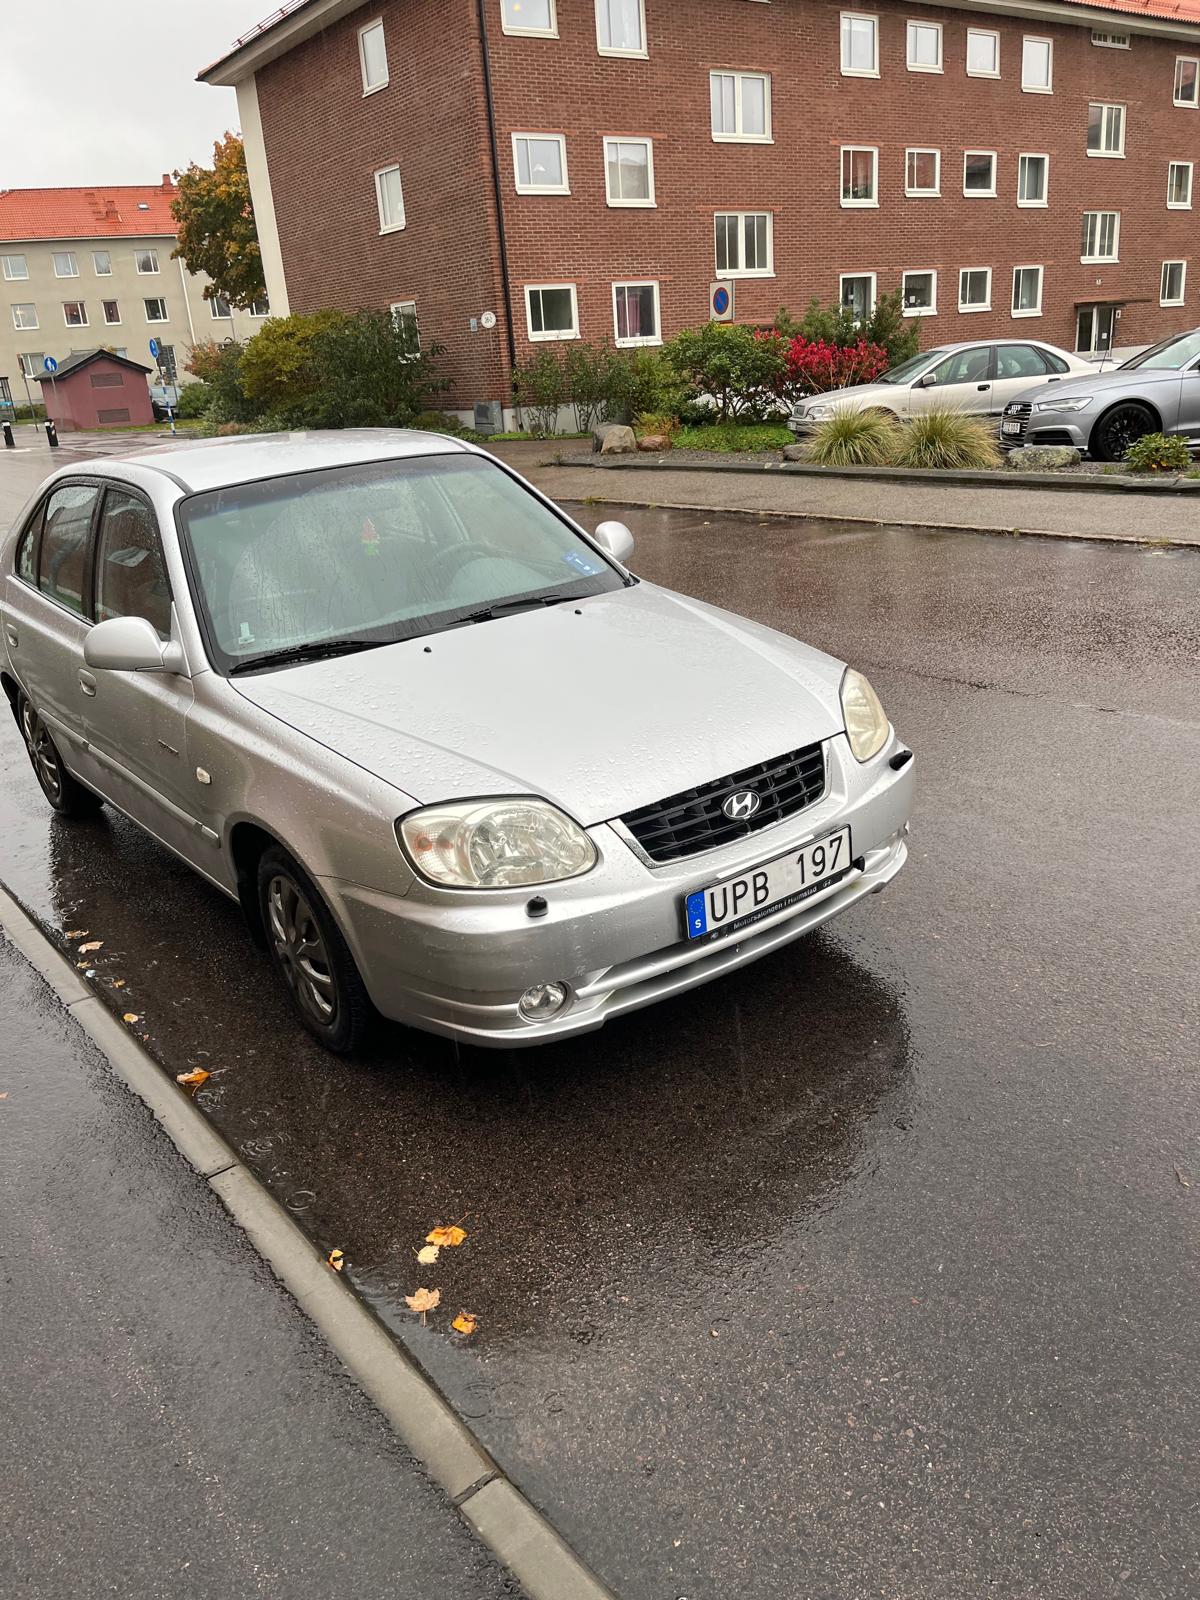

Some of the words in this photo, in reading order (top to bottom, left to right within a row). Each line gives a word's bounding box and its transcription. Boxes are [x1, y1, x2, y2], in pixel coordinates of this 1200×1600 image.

[710, 871, 769, 922] UPB
[796, 835, 843, 885] 197
[694, 919, 702, 929] S
